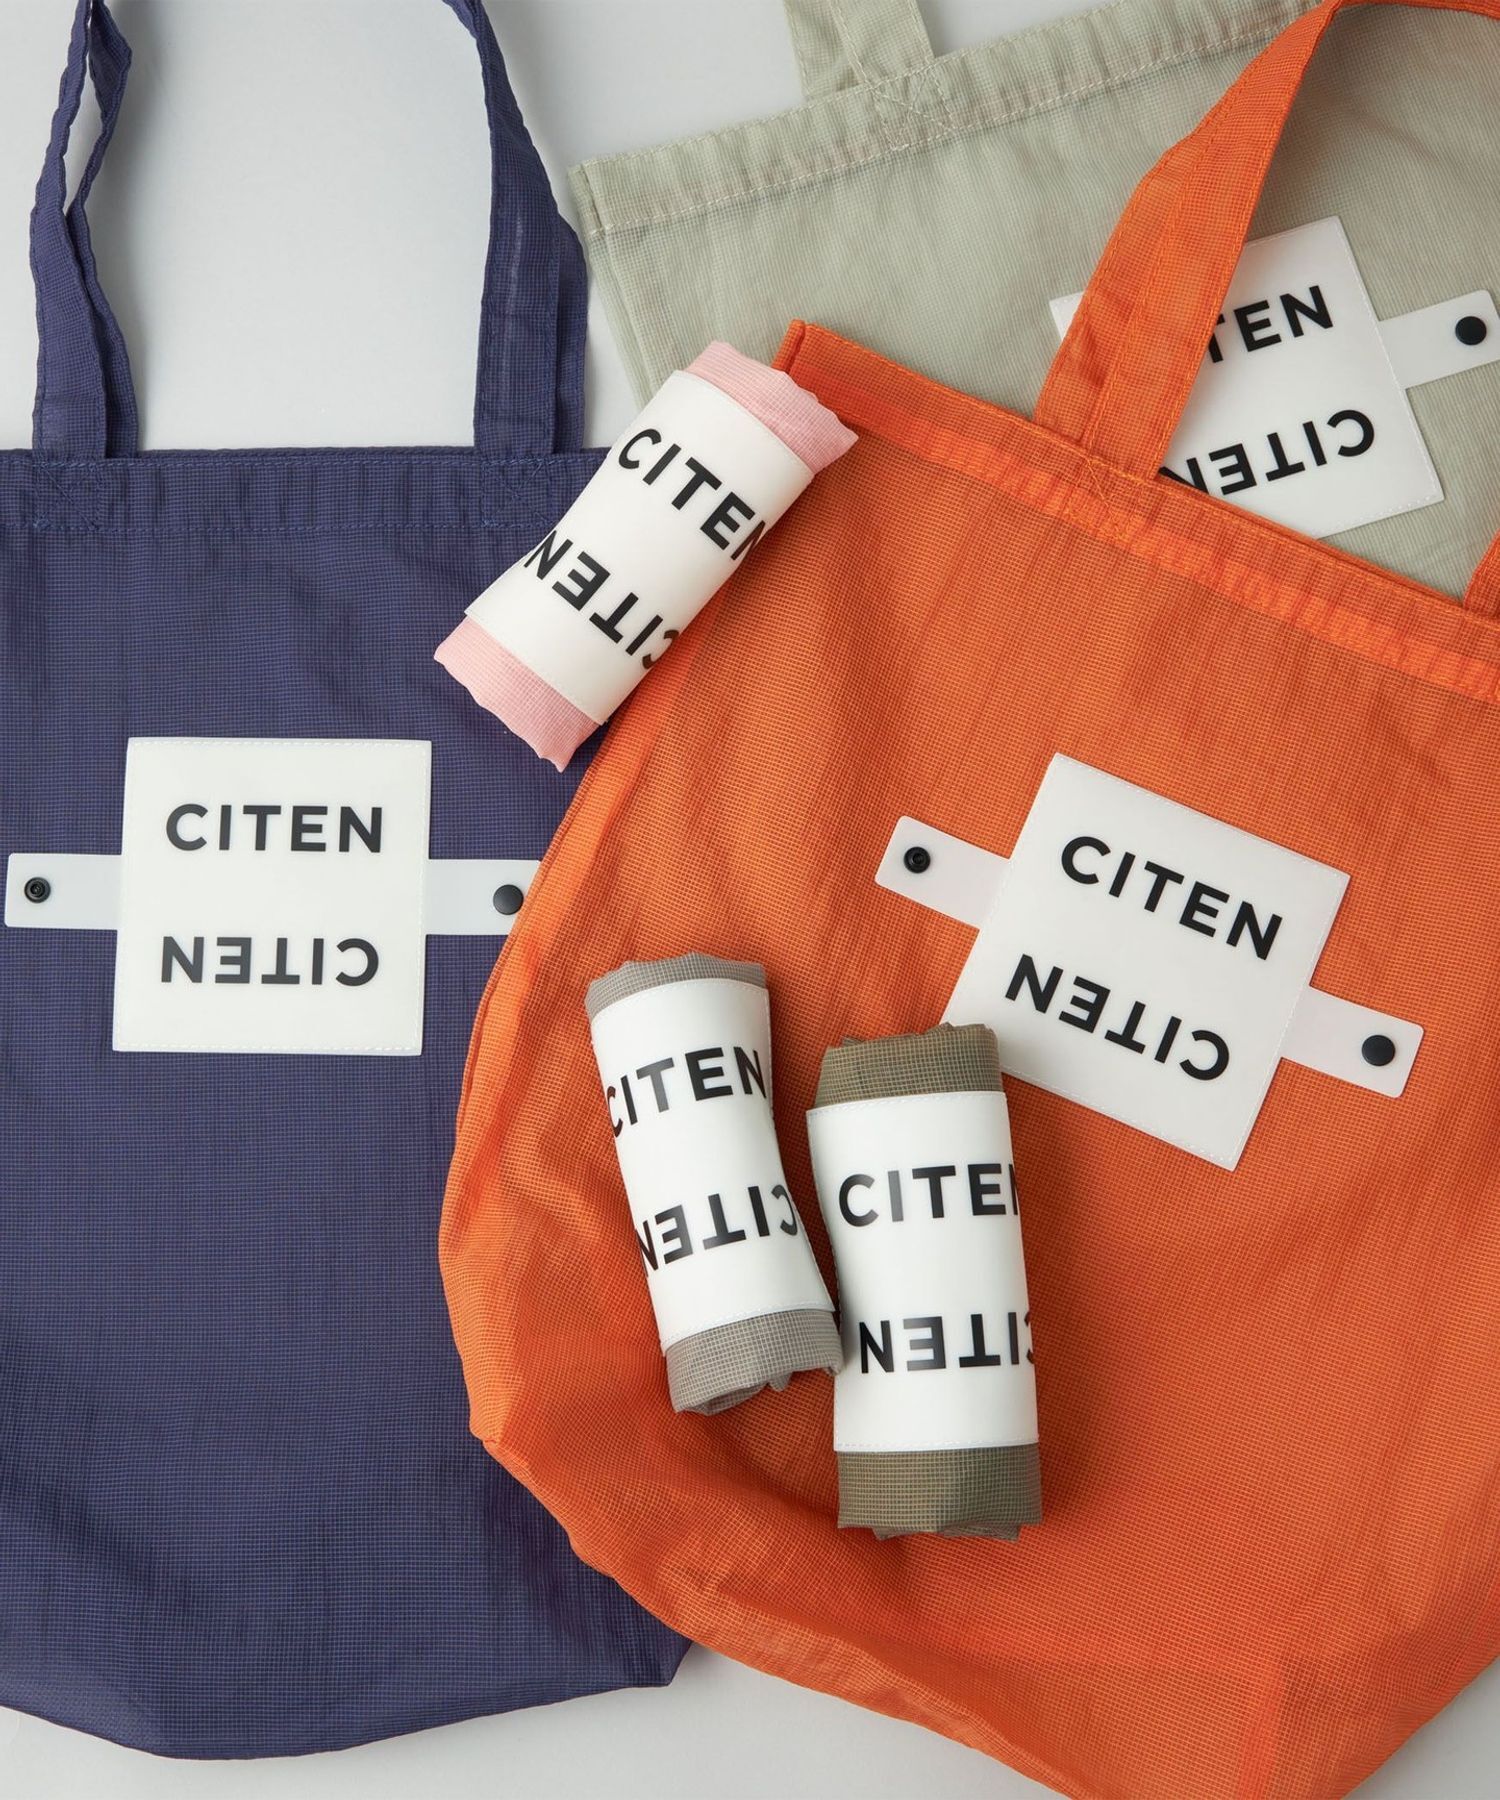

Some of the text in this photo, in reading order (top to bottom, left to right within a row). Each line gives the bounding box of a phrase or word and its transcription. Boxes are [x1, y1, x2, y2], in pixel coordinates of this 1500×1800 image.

[165, 803, 383, 854] CITEN
[1060, 835, 1284, 961] CITEN
[160, 935, 379, 987] CITEN
[1004, 953, 1231, 1081] CITEN
[605, 1045, 767, 1139] CITEN
[634, 1184, 799, 1278] CITEN
